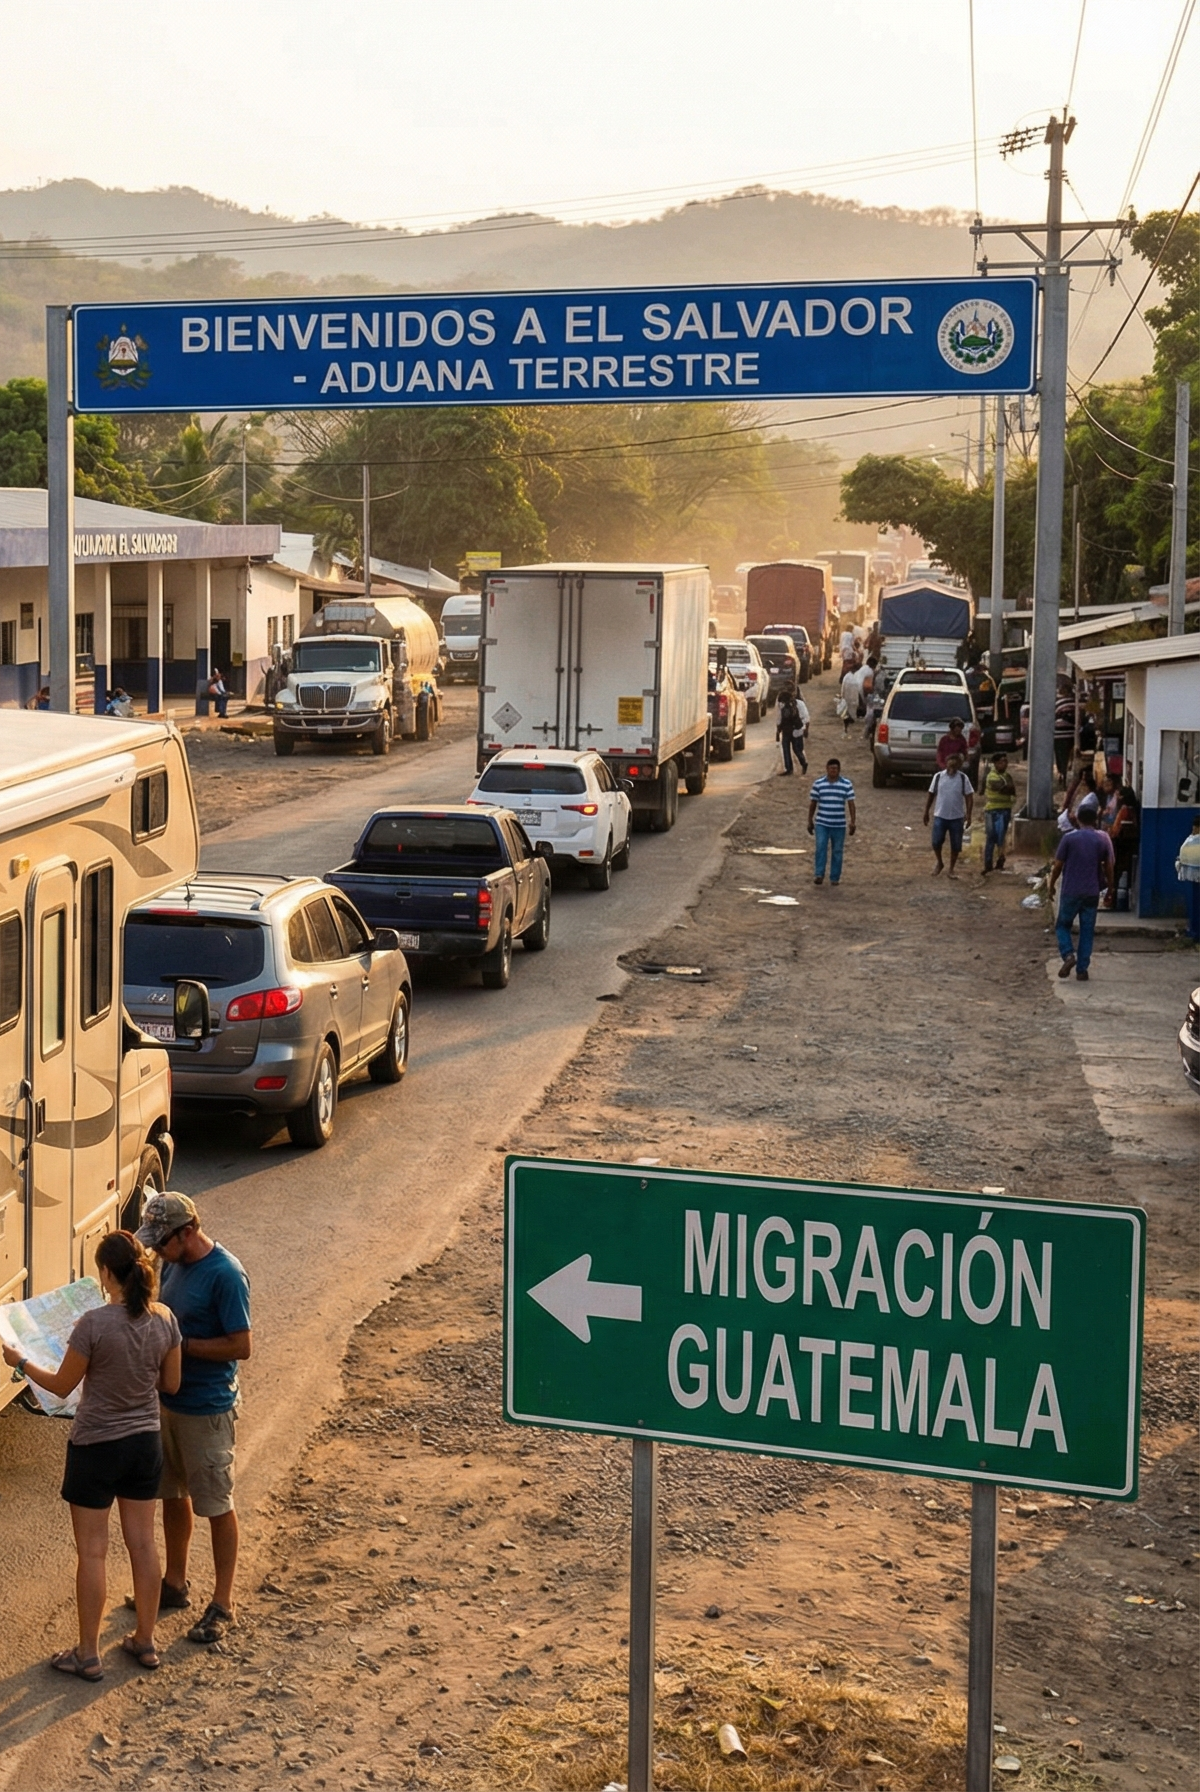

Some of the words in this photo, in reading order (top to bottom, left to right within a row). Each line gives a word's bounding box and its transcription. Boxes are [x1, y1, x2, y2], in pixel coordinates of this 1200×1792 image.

[182, 309, 496, 353] BIENVENIDOS
[512, 307, 547, 344] A
[565, 306, 624, 343] EL
[642, 296, 914, 341] SALVADOR
[320, 359, 494, 394] ADUANA
[508, 353, 760, 390] TERRESTRE
[684, 1209, 1053, 1330] MIGRACIÓN
[667, 1323, 1068, 1453] GUATEMALA
